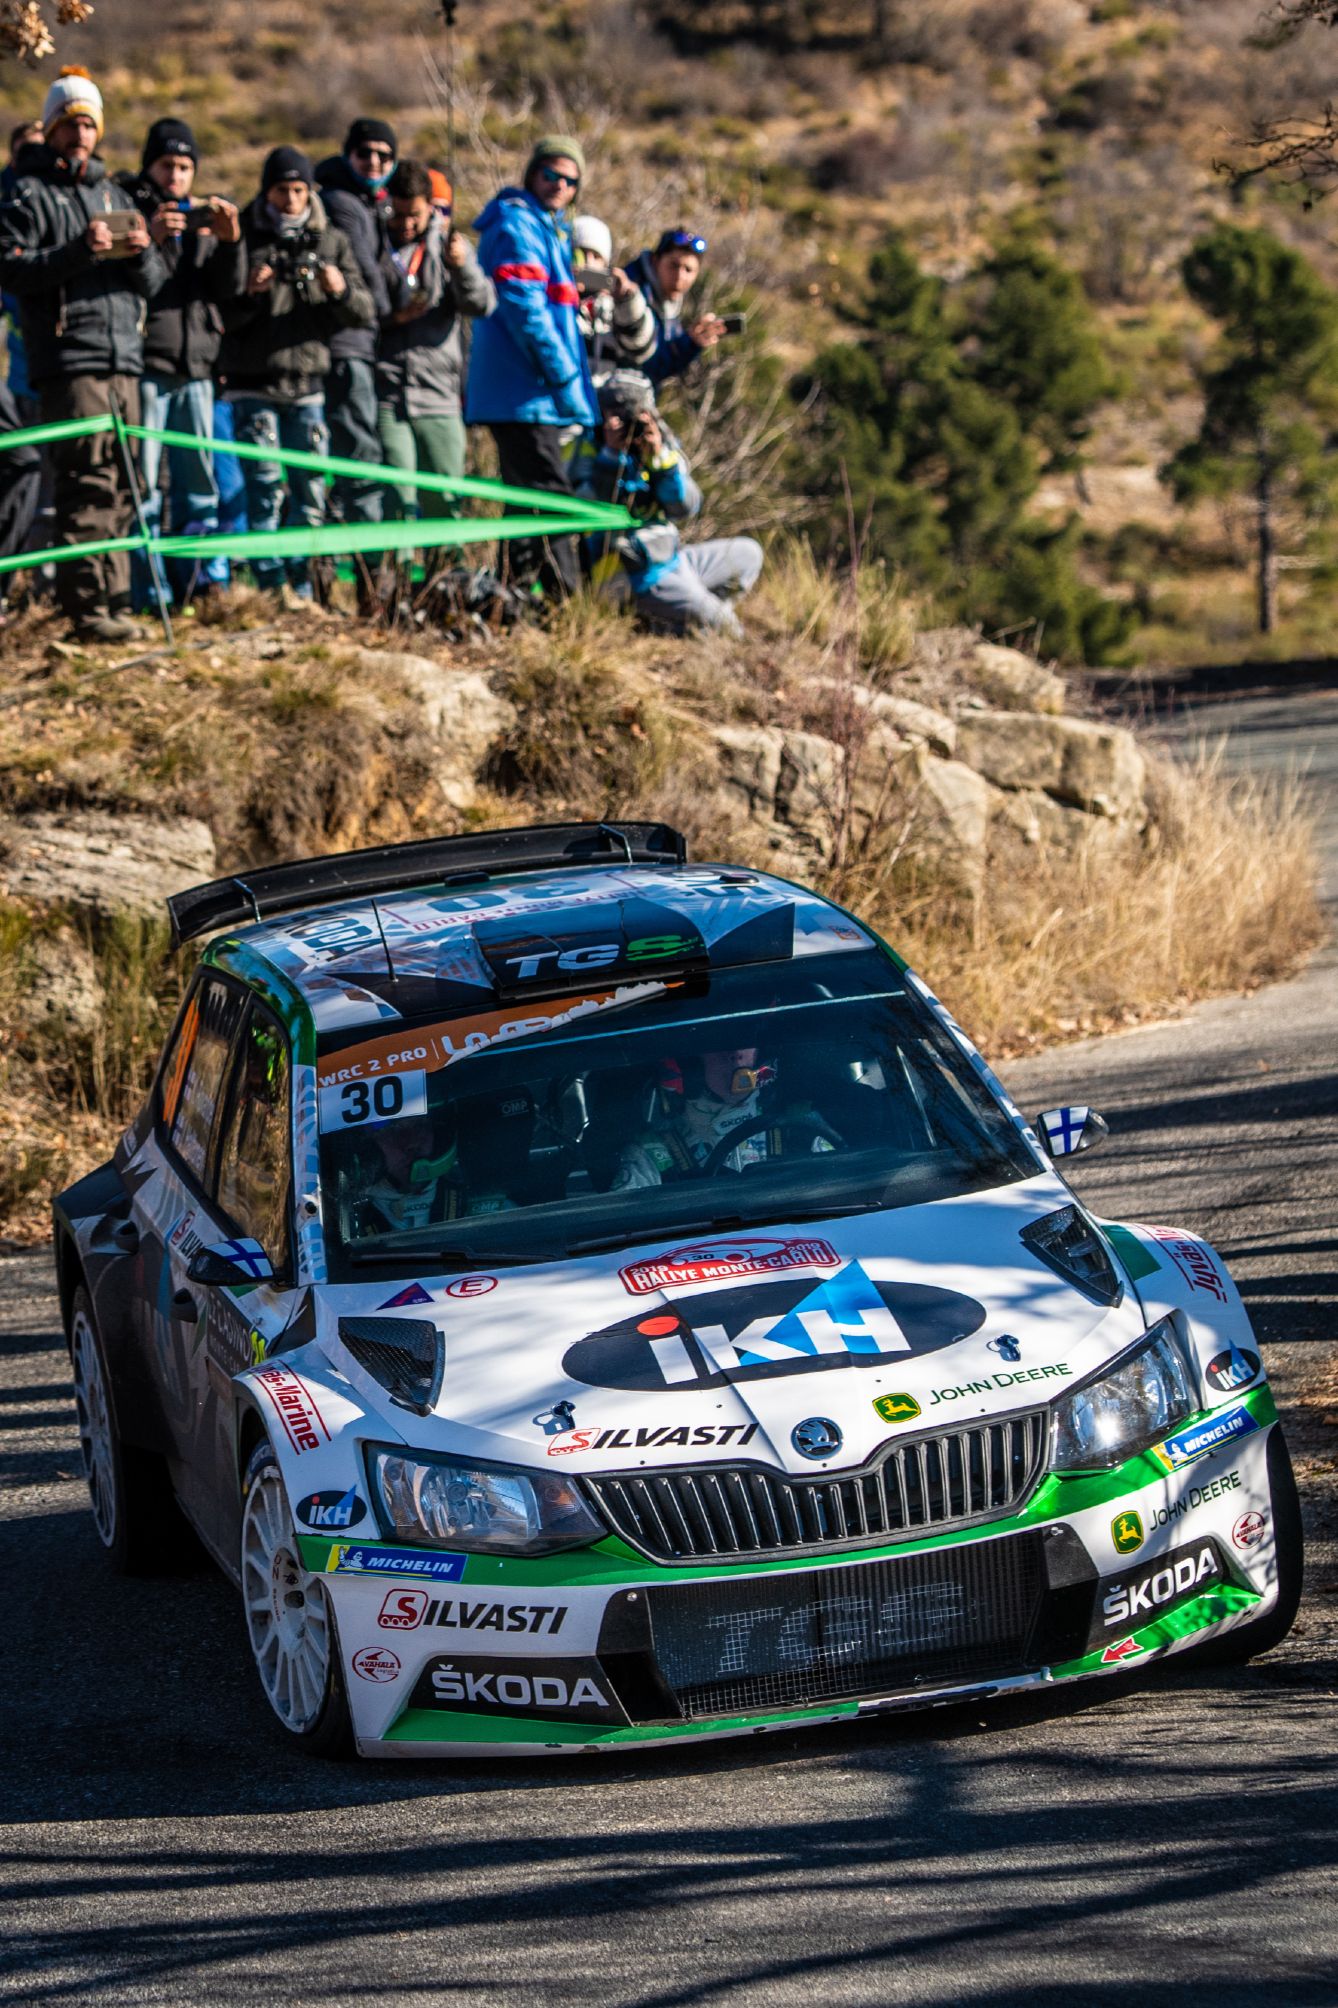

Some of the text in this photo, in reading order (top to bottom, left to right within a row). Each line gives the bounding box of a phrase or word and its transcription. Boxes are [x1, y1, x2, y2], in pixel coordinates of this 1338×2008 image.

[506, 935, 700, 978] TGS
[319, 1047, 427, 1087] WRC 2 PRO
[341, 1076, 403, 1122] 30
[630, 1265, 669, 1275] 2019
[692, 1253, 714, 1261] 30
[460, 1279, 485, 1293] E
[633, 1268, 697, 1290] RALLYE
[930, 1363, 1073, 1405] JOHN DEERE
[570, 1422, 760, 1450] SILVASTI
[1183, 1416, 1244, 1453] MICHELIN
[1150, 1470, 1242, 1531] JOHN DEERE
[366, 1556, 454, 1574] MICHELIN
[1102, 1547, 1218, 1627] ŠKODA
[397, 1596, 568, 1635] SILVASTI
[432, 1664, 610, 1708] ŠKODA
